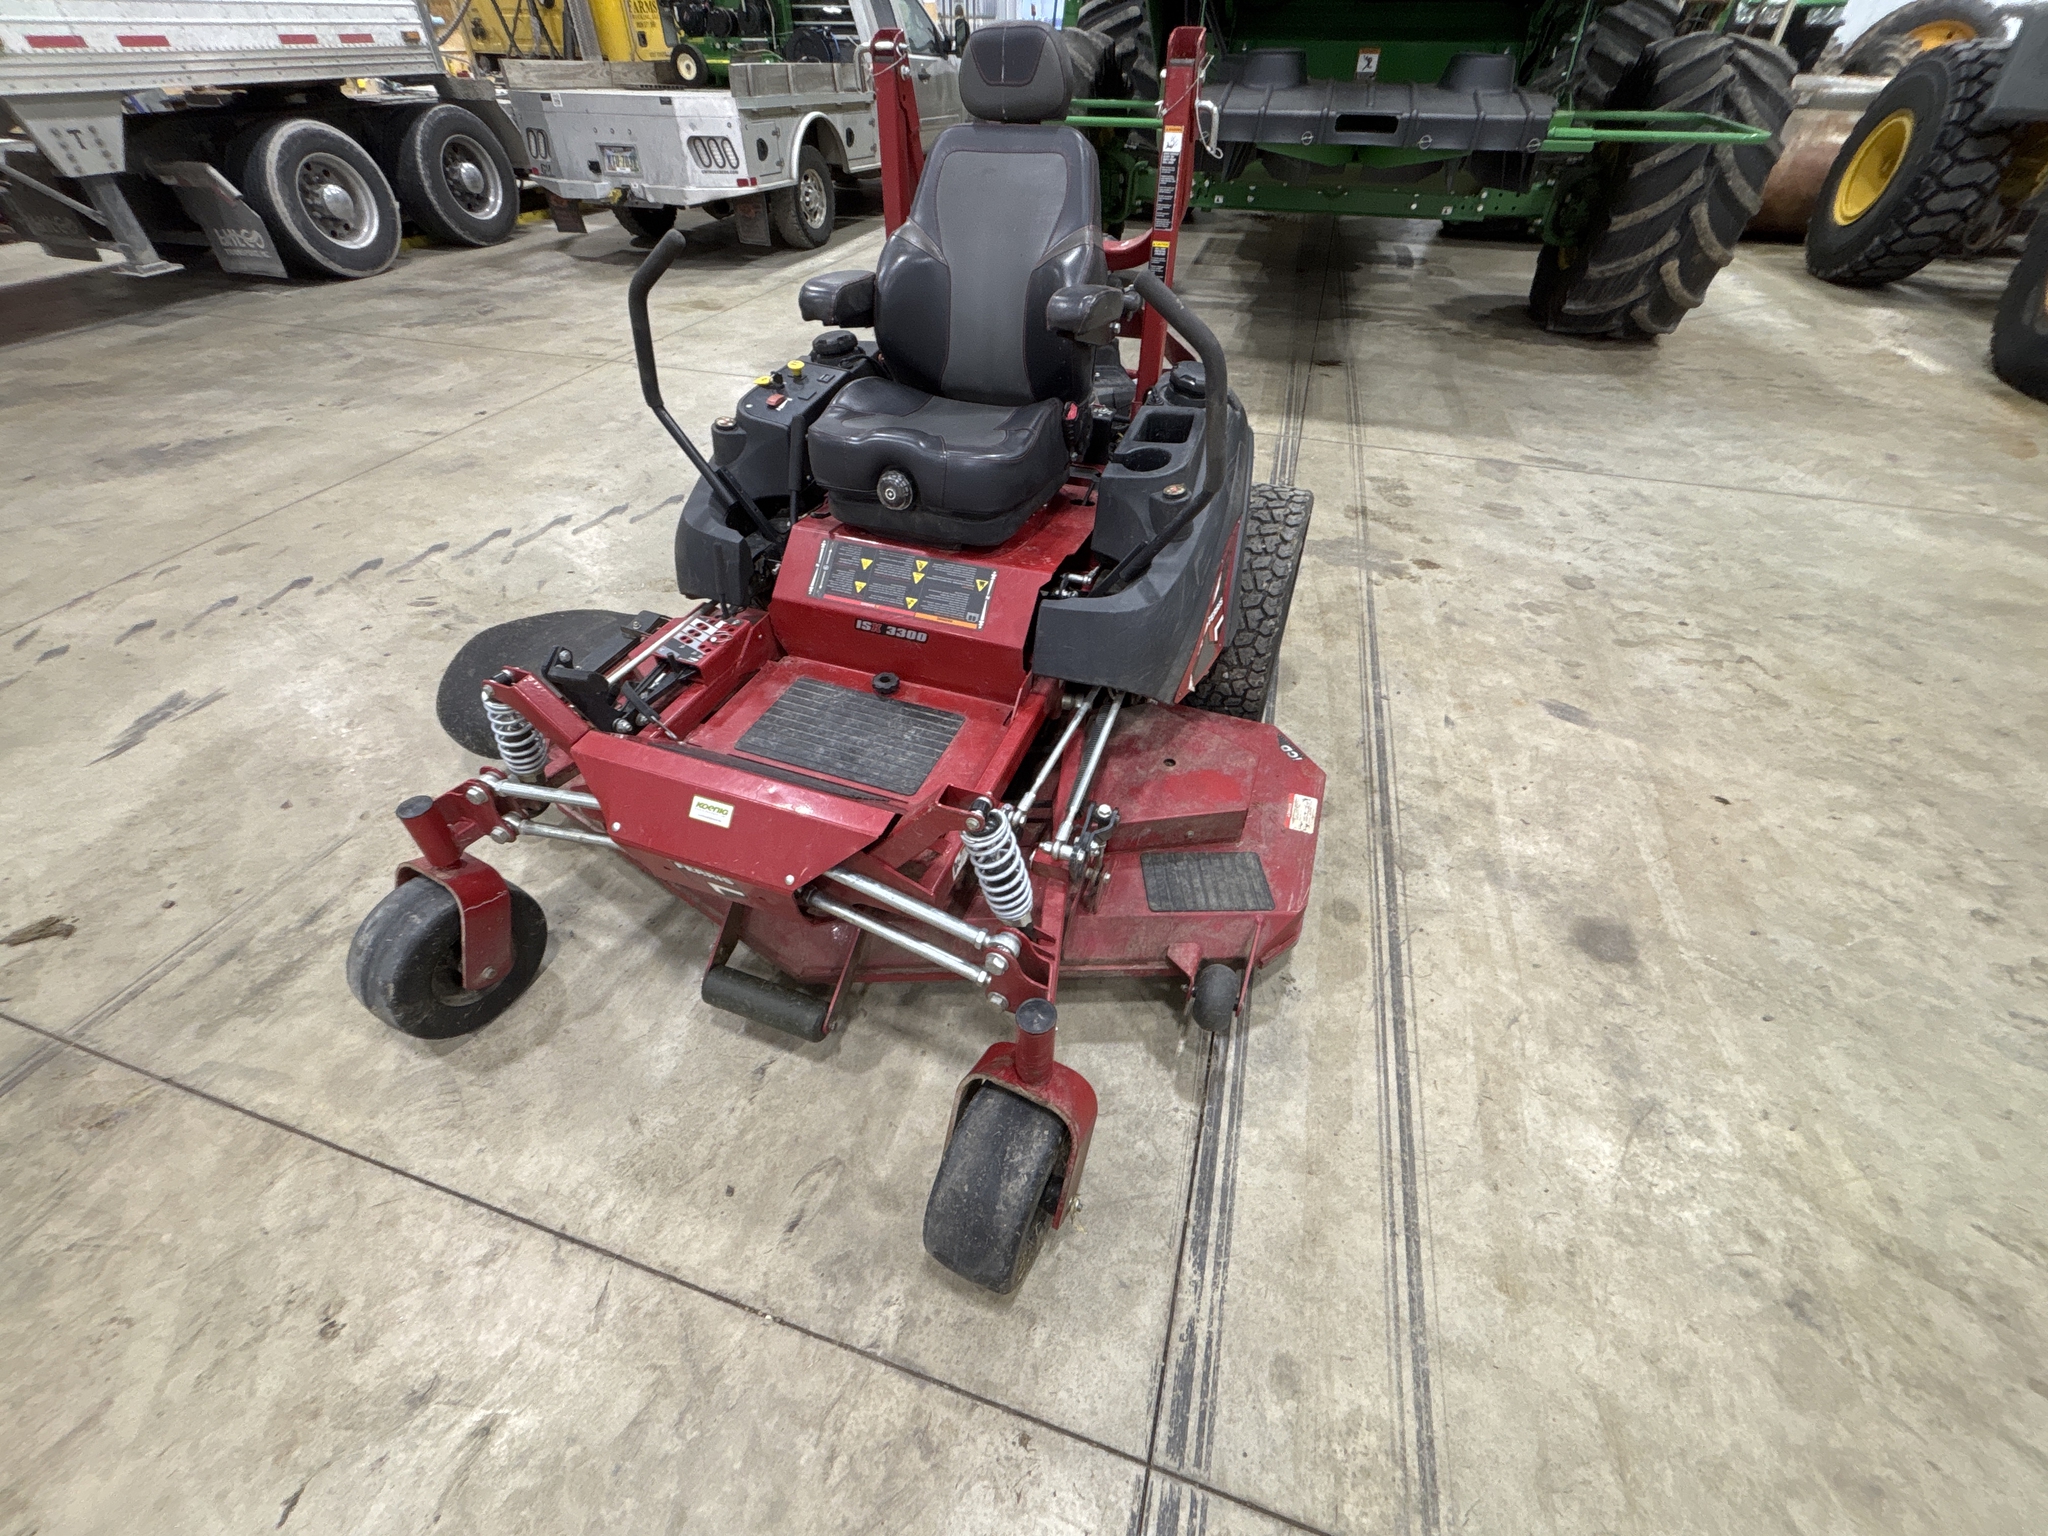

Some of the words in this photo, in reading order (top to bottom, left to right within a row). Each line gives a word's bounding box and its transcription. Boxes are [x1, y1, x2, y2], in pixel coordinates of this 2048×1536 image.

[629, 0, 658, 13] FARMS
[66, 128, 88, 150] T
[856, 619, 882, 634] ISX
[886, 626, 928, 642] 3300
